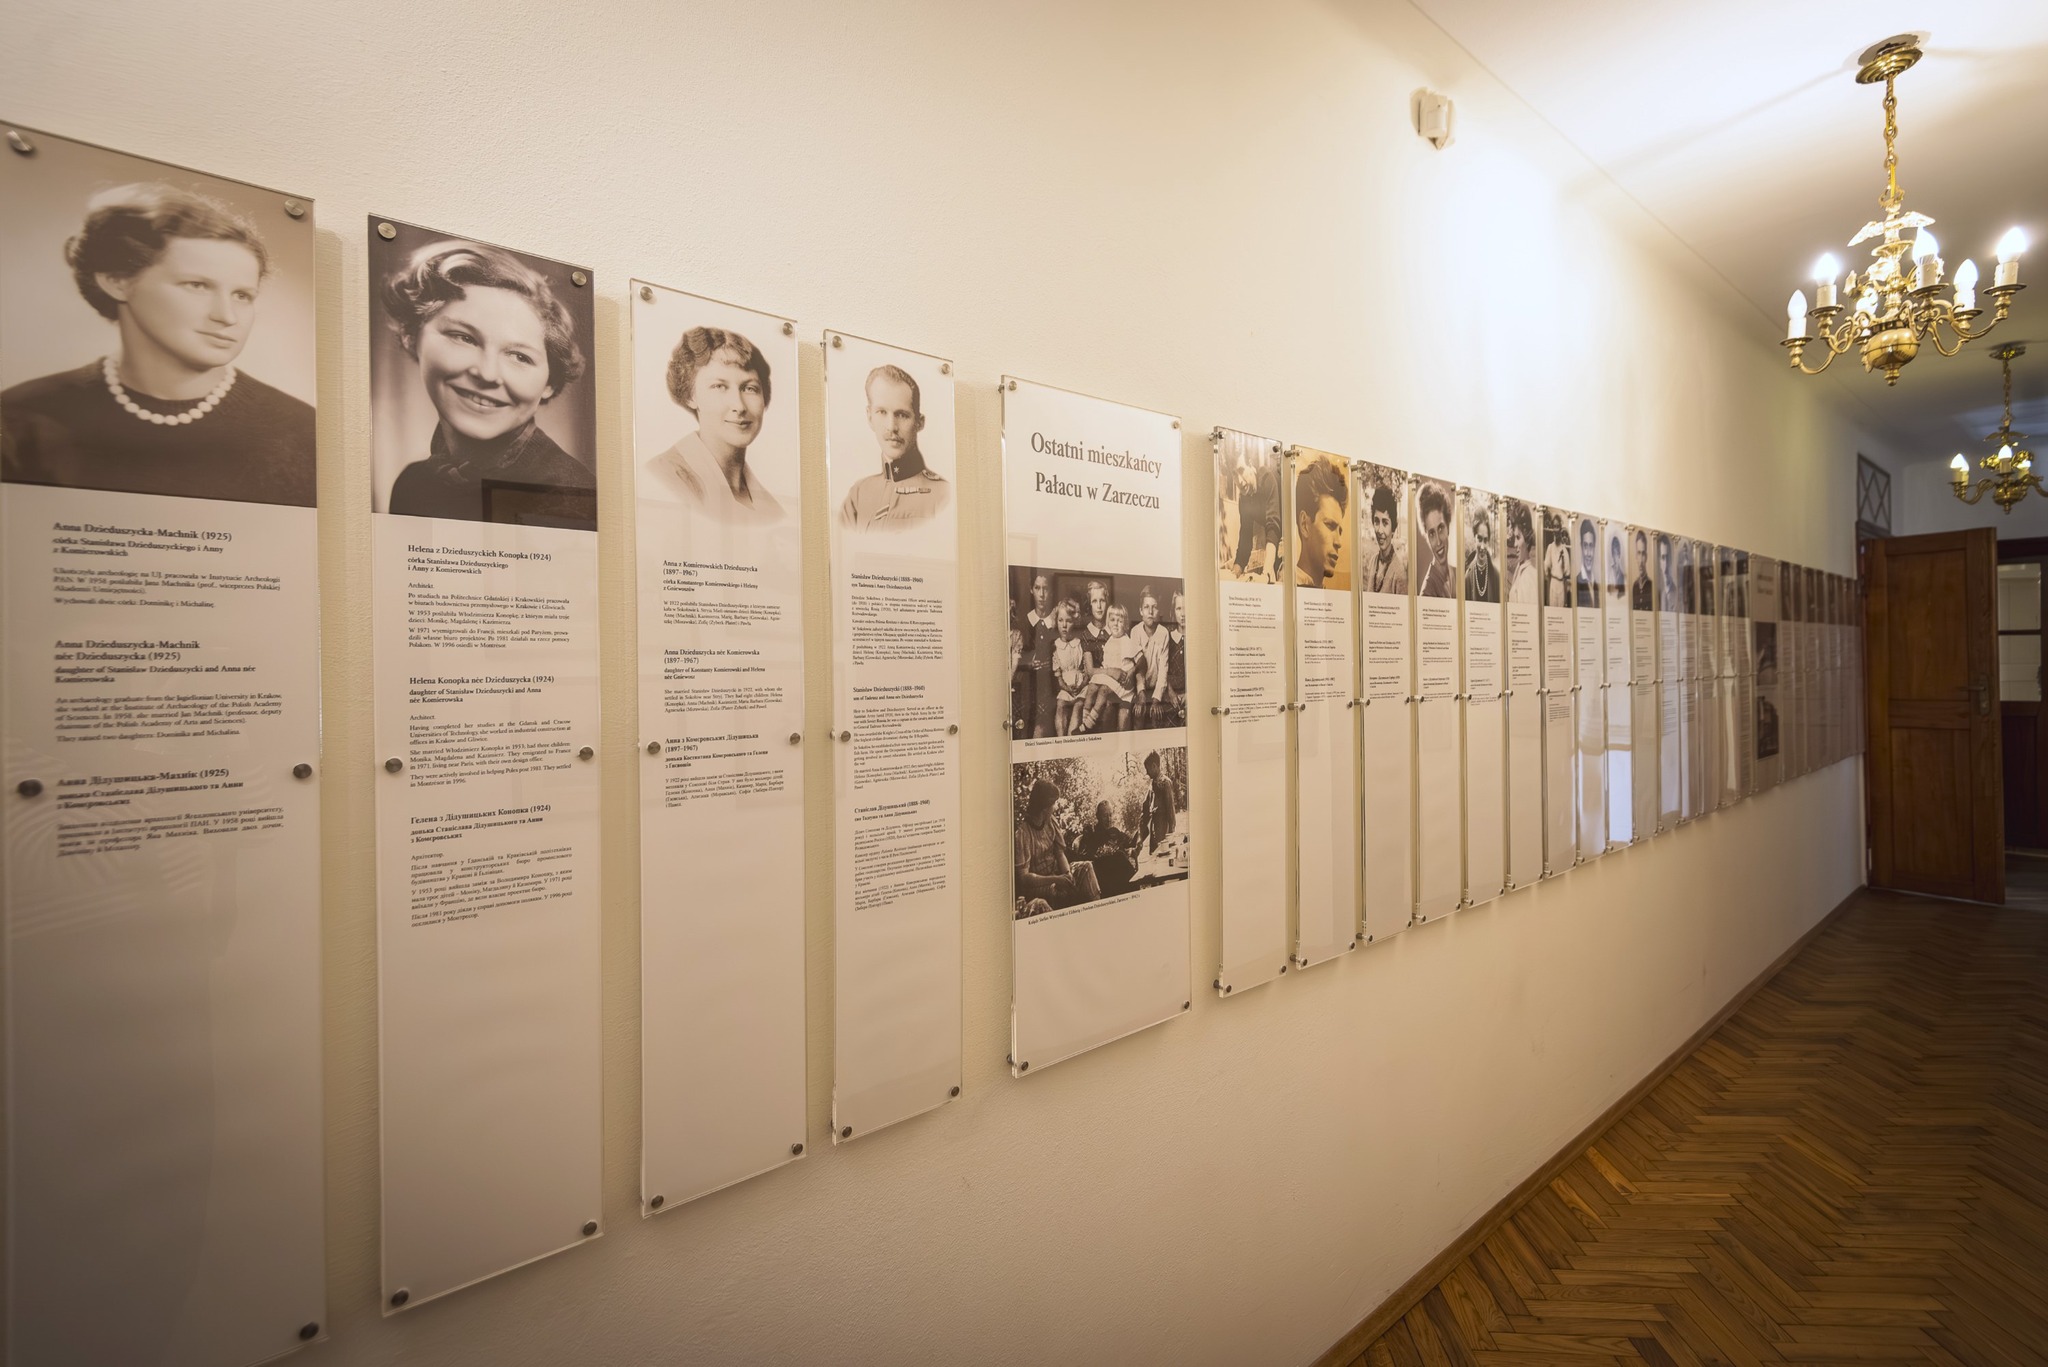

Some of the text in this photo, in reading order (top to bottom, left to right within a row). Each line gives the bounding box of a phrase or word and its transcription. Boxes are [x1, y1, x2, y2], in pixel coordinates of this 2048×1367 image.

[1031, 432, 1161, 478] Ostatni mieszkańcy
[1036, 472, 1159, 509] Pałacu w Zarzeczu
[201, 532, 232, 541] (1925)
[408, 545, 434, 553] Helena
[442, 547, 497, 557] Dzieduszyckich
[499, 551, 528, 559] Konopka
[530, 553, 551, 561] (1924)
[427, 558, 459, 567] Stanisława
[460, 560, 508, 569] Dzieduszyckiego
[148, 652, 181, 661] (1925)
[438, 677, 469, 685] Konopka
[199, 769, 229, 778] (1925)
[530, 805, 551, 813] (1924)
